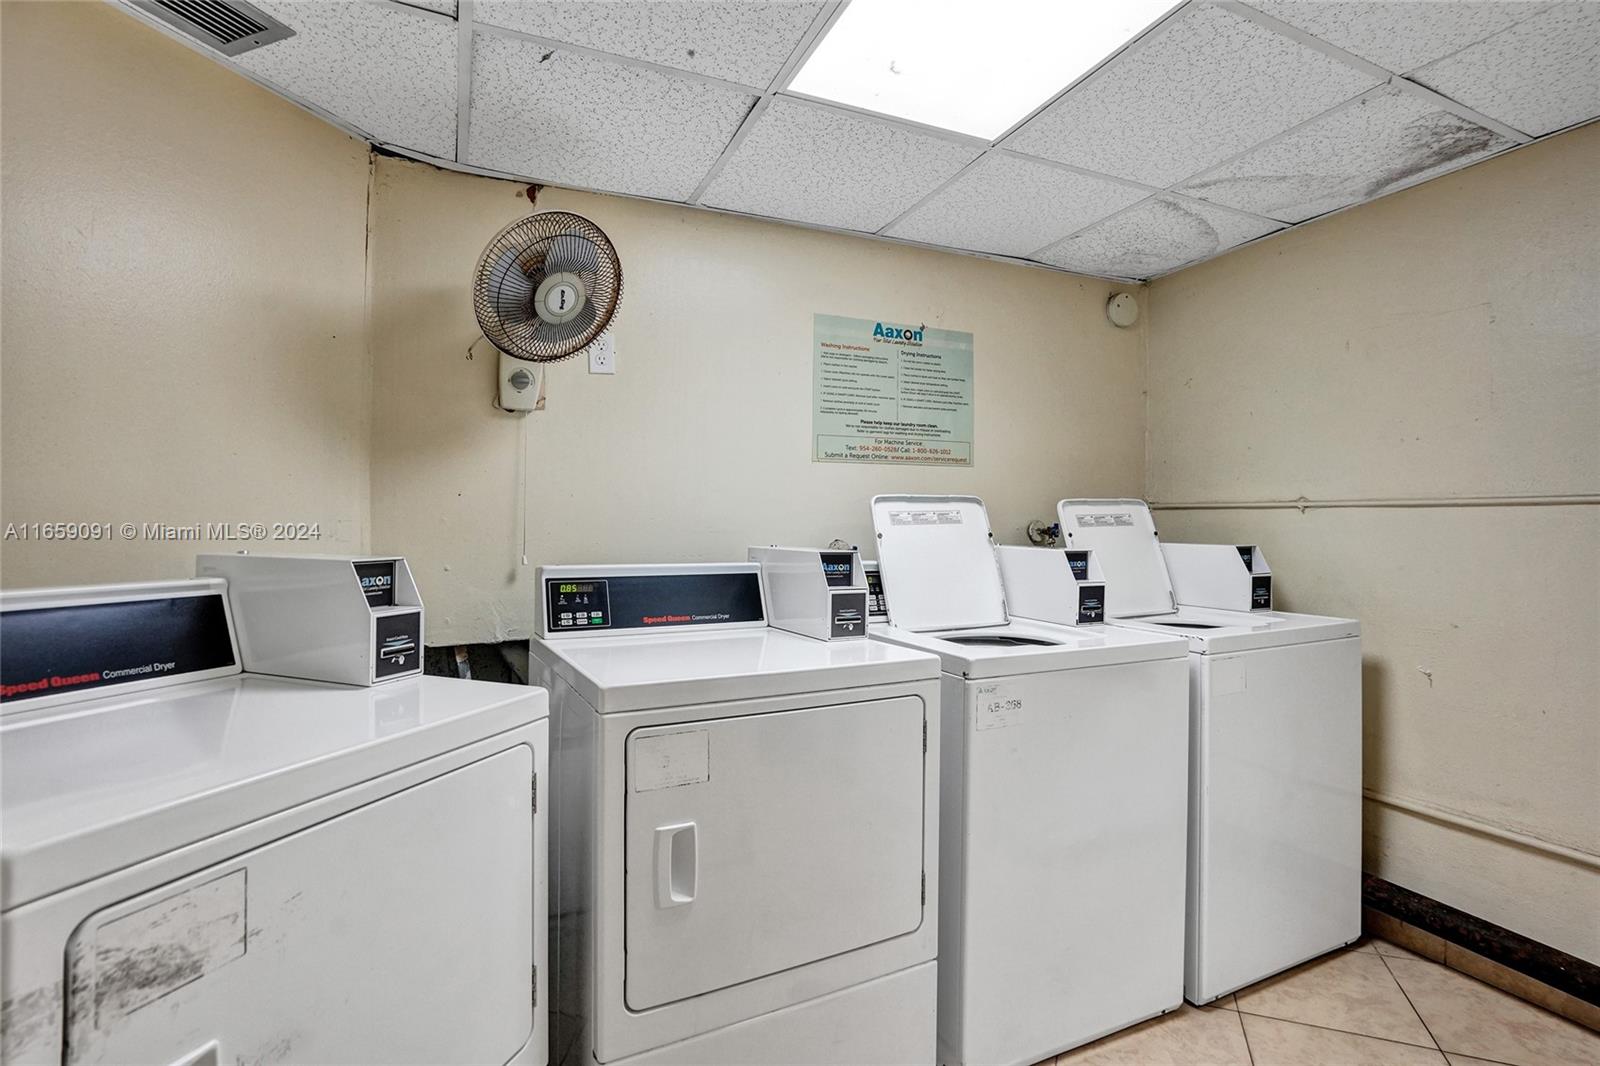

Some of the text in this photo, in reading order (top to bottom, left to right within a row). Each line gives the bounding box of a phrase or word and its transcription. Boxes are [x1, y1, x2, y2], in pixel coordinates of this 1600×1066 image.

[873, 322, 923, 342] Aaxon
[821, 342, 841, 350] Washing
[824, 451, 844, 459] Submit
[849, 452, 871, 460] Request
[643, 615, 667, 625] Speed
[667, 614, 690, 622] Queen
[691, 613, 717, 621] Commercial
[0, 660, 176, 697] Speed Queen Commercial Dryer
